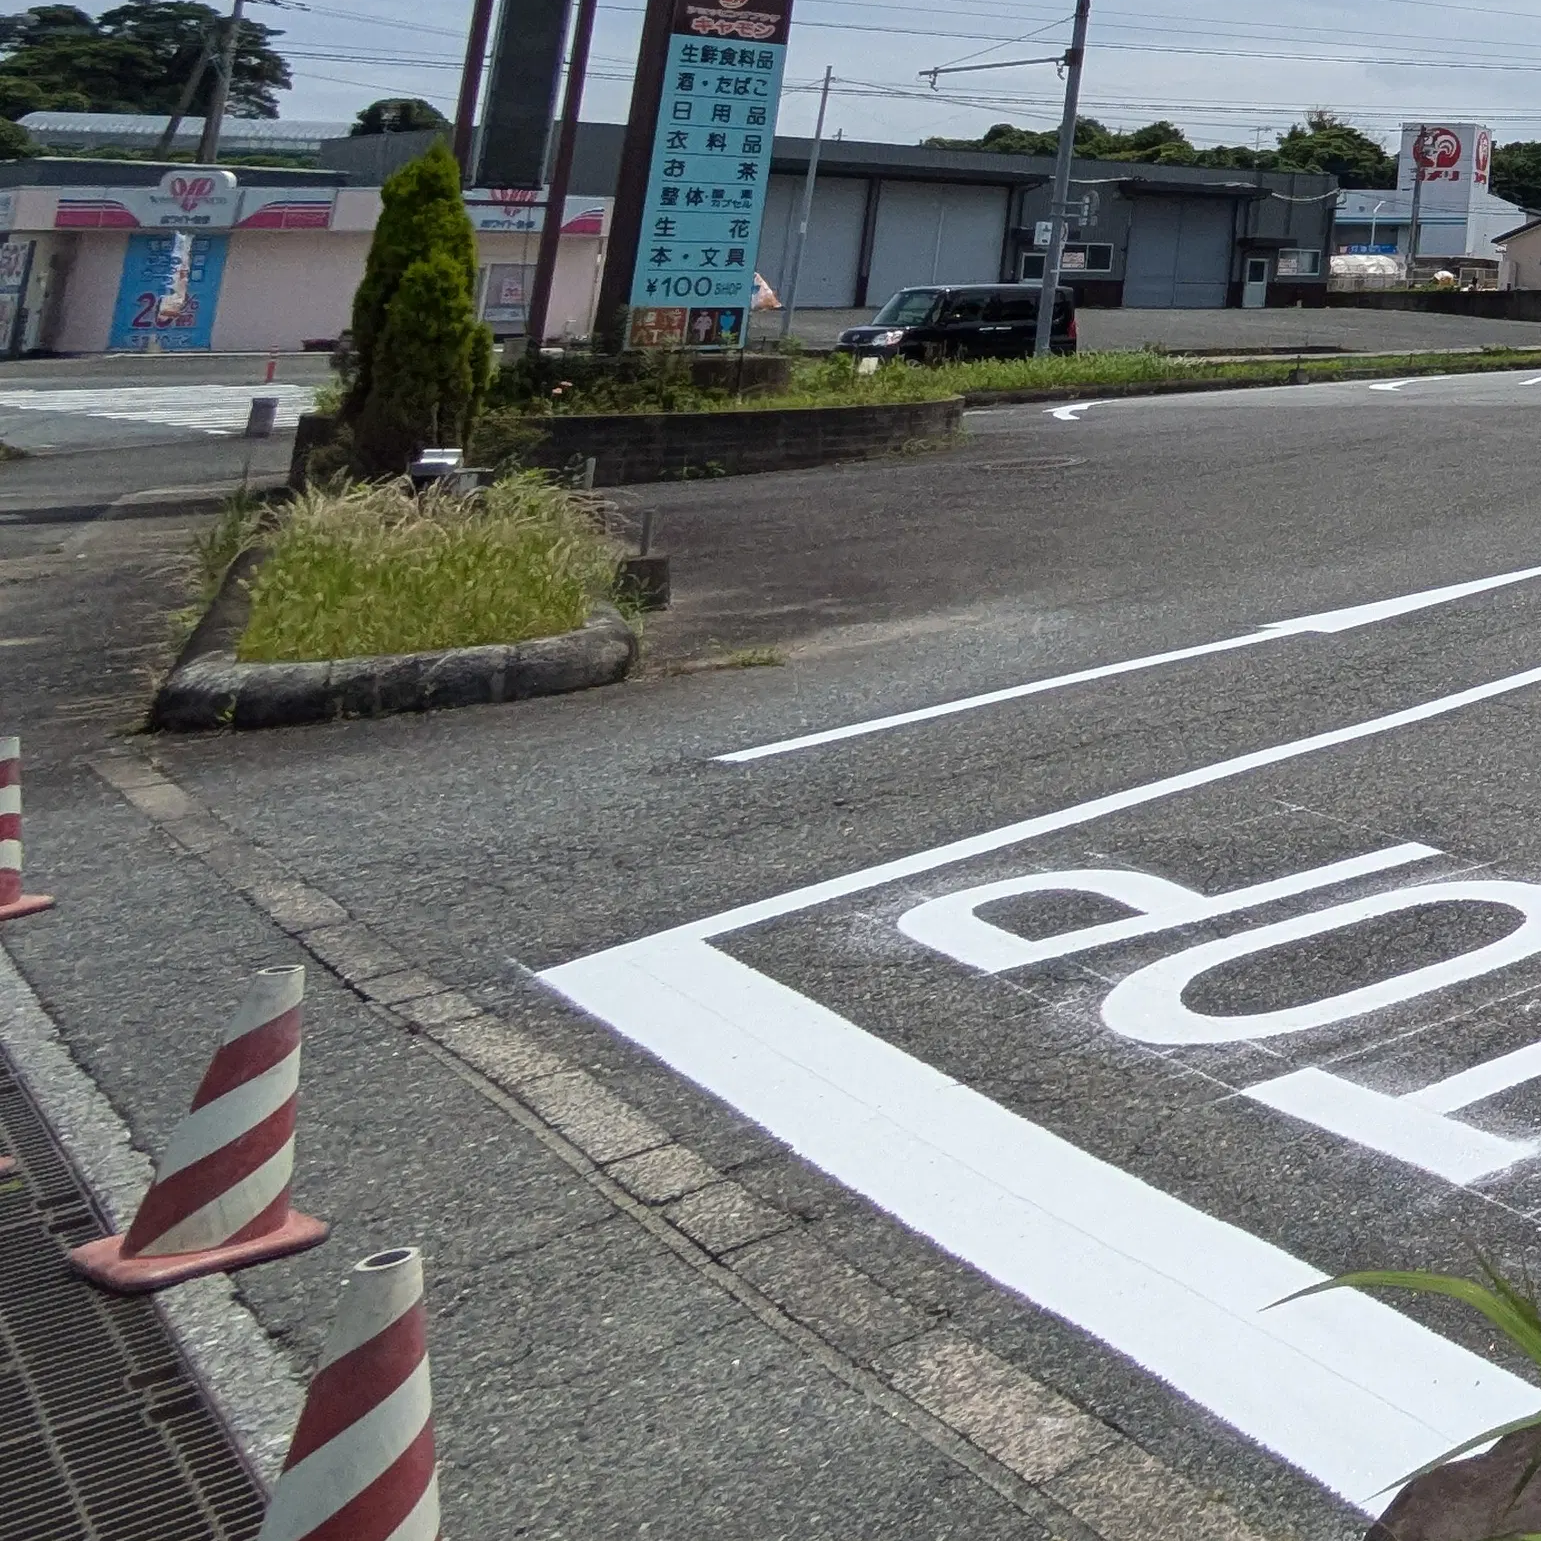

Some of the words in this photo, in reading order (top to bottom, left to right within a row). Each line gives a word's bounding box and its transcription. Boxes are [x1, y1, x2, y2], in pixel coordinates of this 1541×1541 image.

[691, 16, 776, 39] キャモン
[680, 43, 774, 70] 生鮮食料品
[646, 276, 712, 297] ¥100
[714, 282, 742, 296] SHOP
